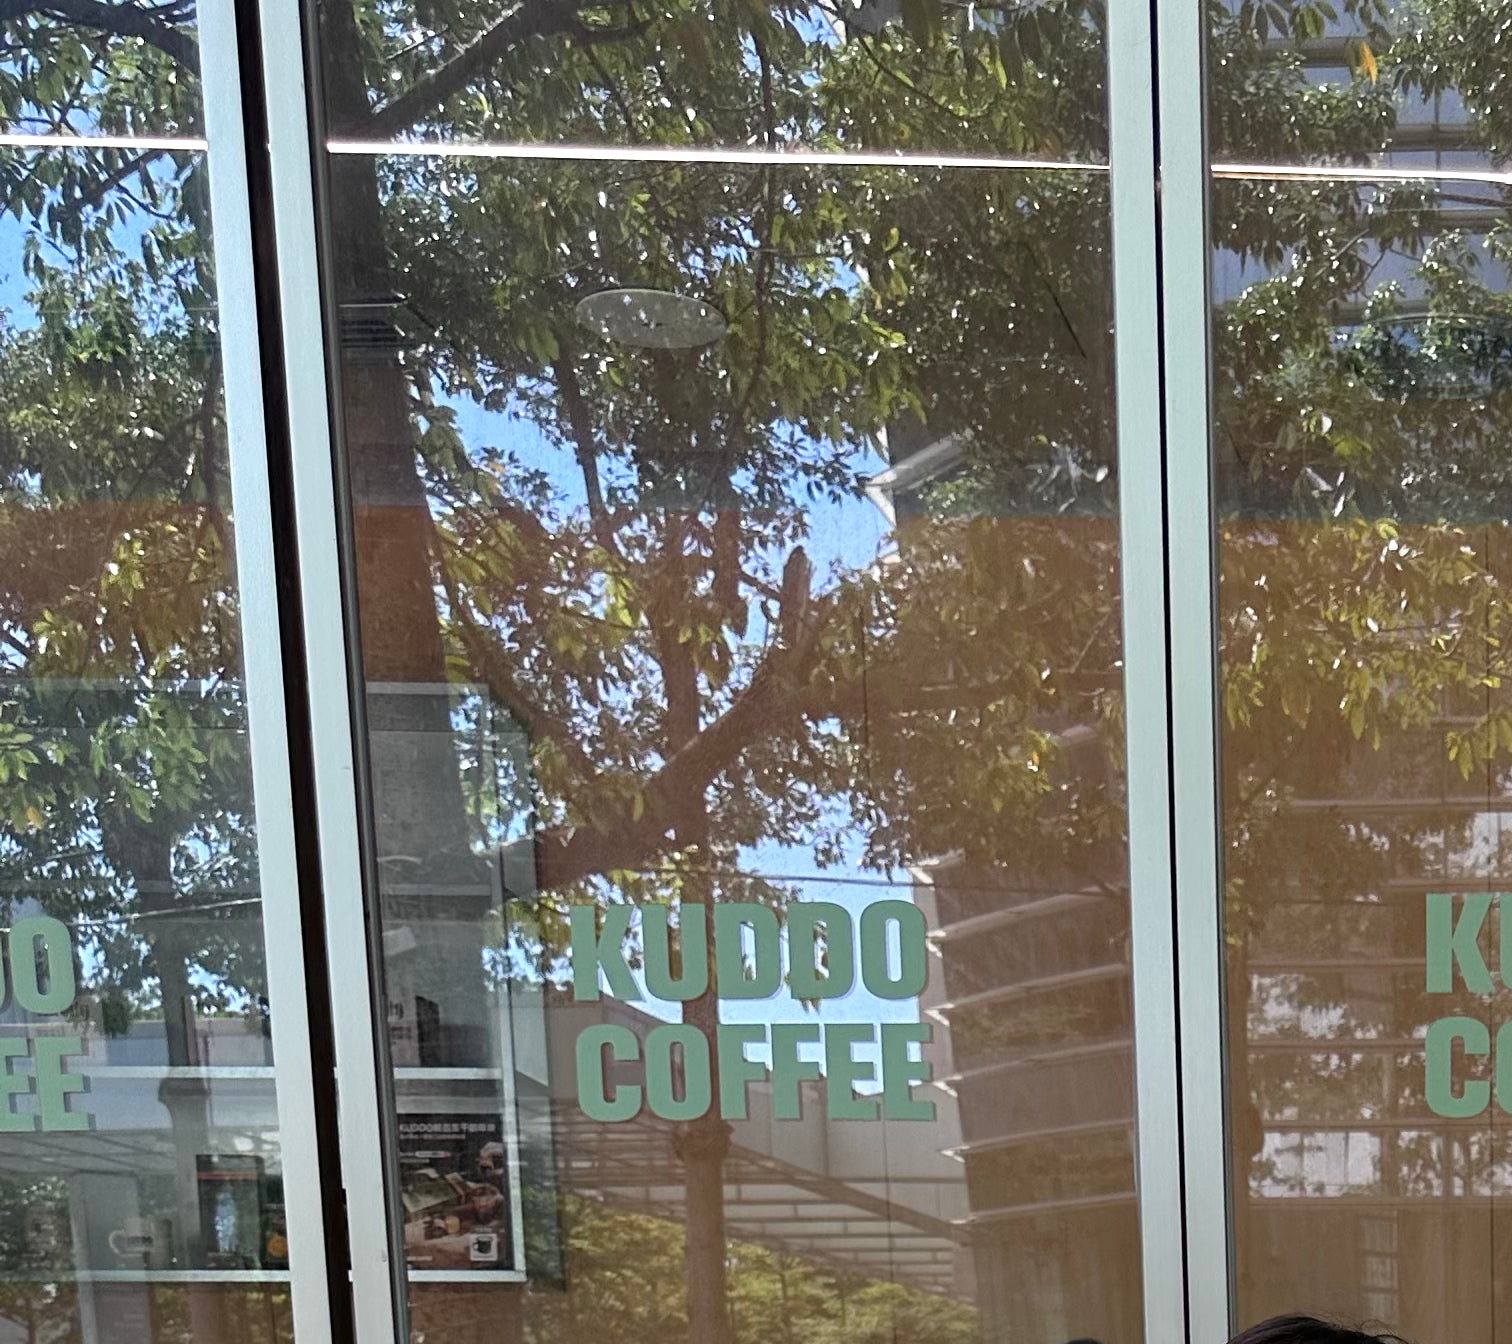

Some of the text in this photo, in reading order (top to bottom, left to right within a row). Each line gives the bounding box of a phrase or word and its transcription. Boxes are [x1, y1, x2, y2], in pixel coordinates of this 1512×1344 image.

[0, 916, 76, 1014] O
[569, 899, 928, 1003] KUDDO
[575, 1023, 936, 1122] COFFEE
